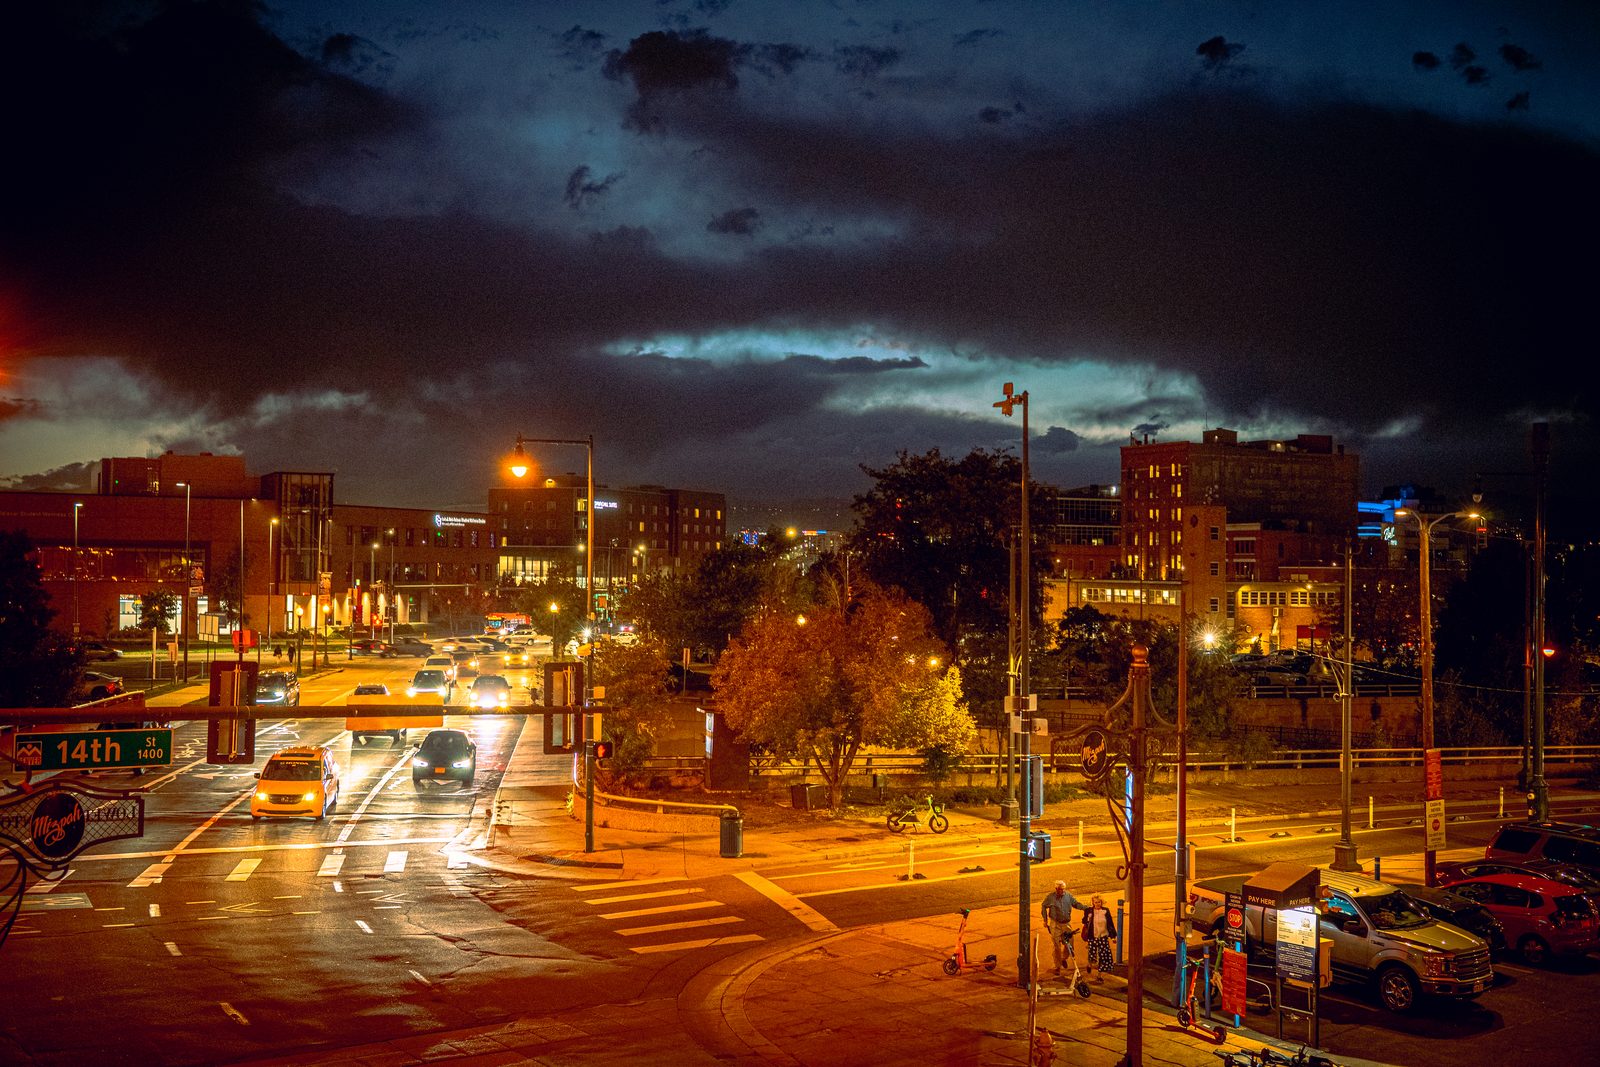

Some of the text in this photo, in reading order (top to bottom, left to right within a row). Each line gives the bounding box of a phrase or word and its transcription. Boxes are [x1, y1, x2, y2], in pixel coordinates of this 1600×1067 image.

[145, 736, 156, 747] St
[57, 736, 121, 764] 14th
[137, 749, 164, 760] 1400
[33, 803, 82, 847] Mizpah
[1247, 895, 1276, 907] PAY HERE
[1229, 912, 1241, 923] STOP
